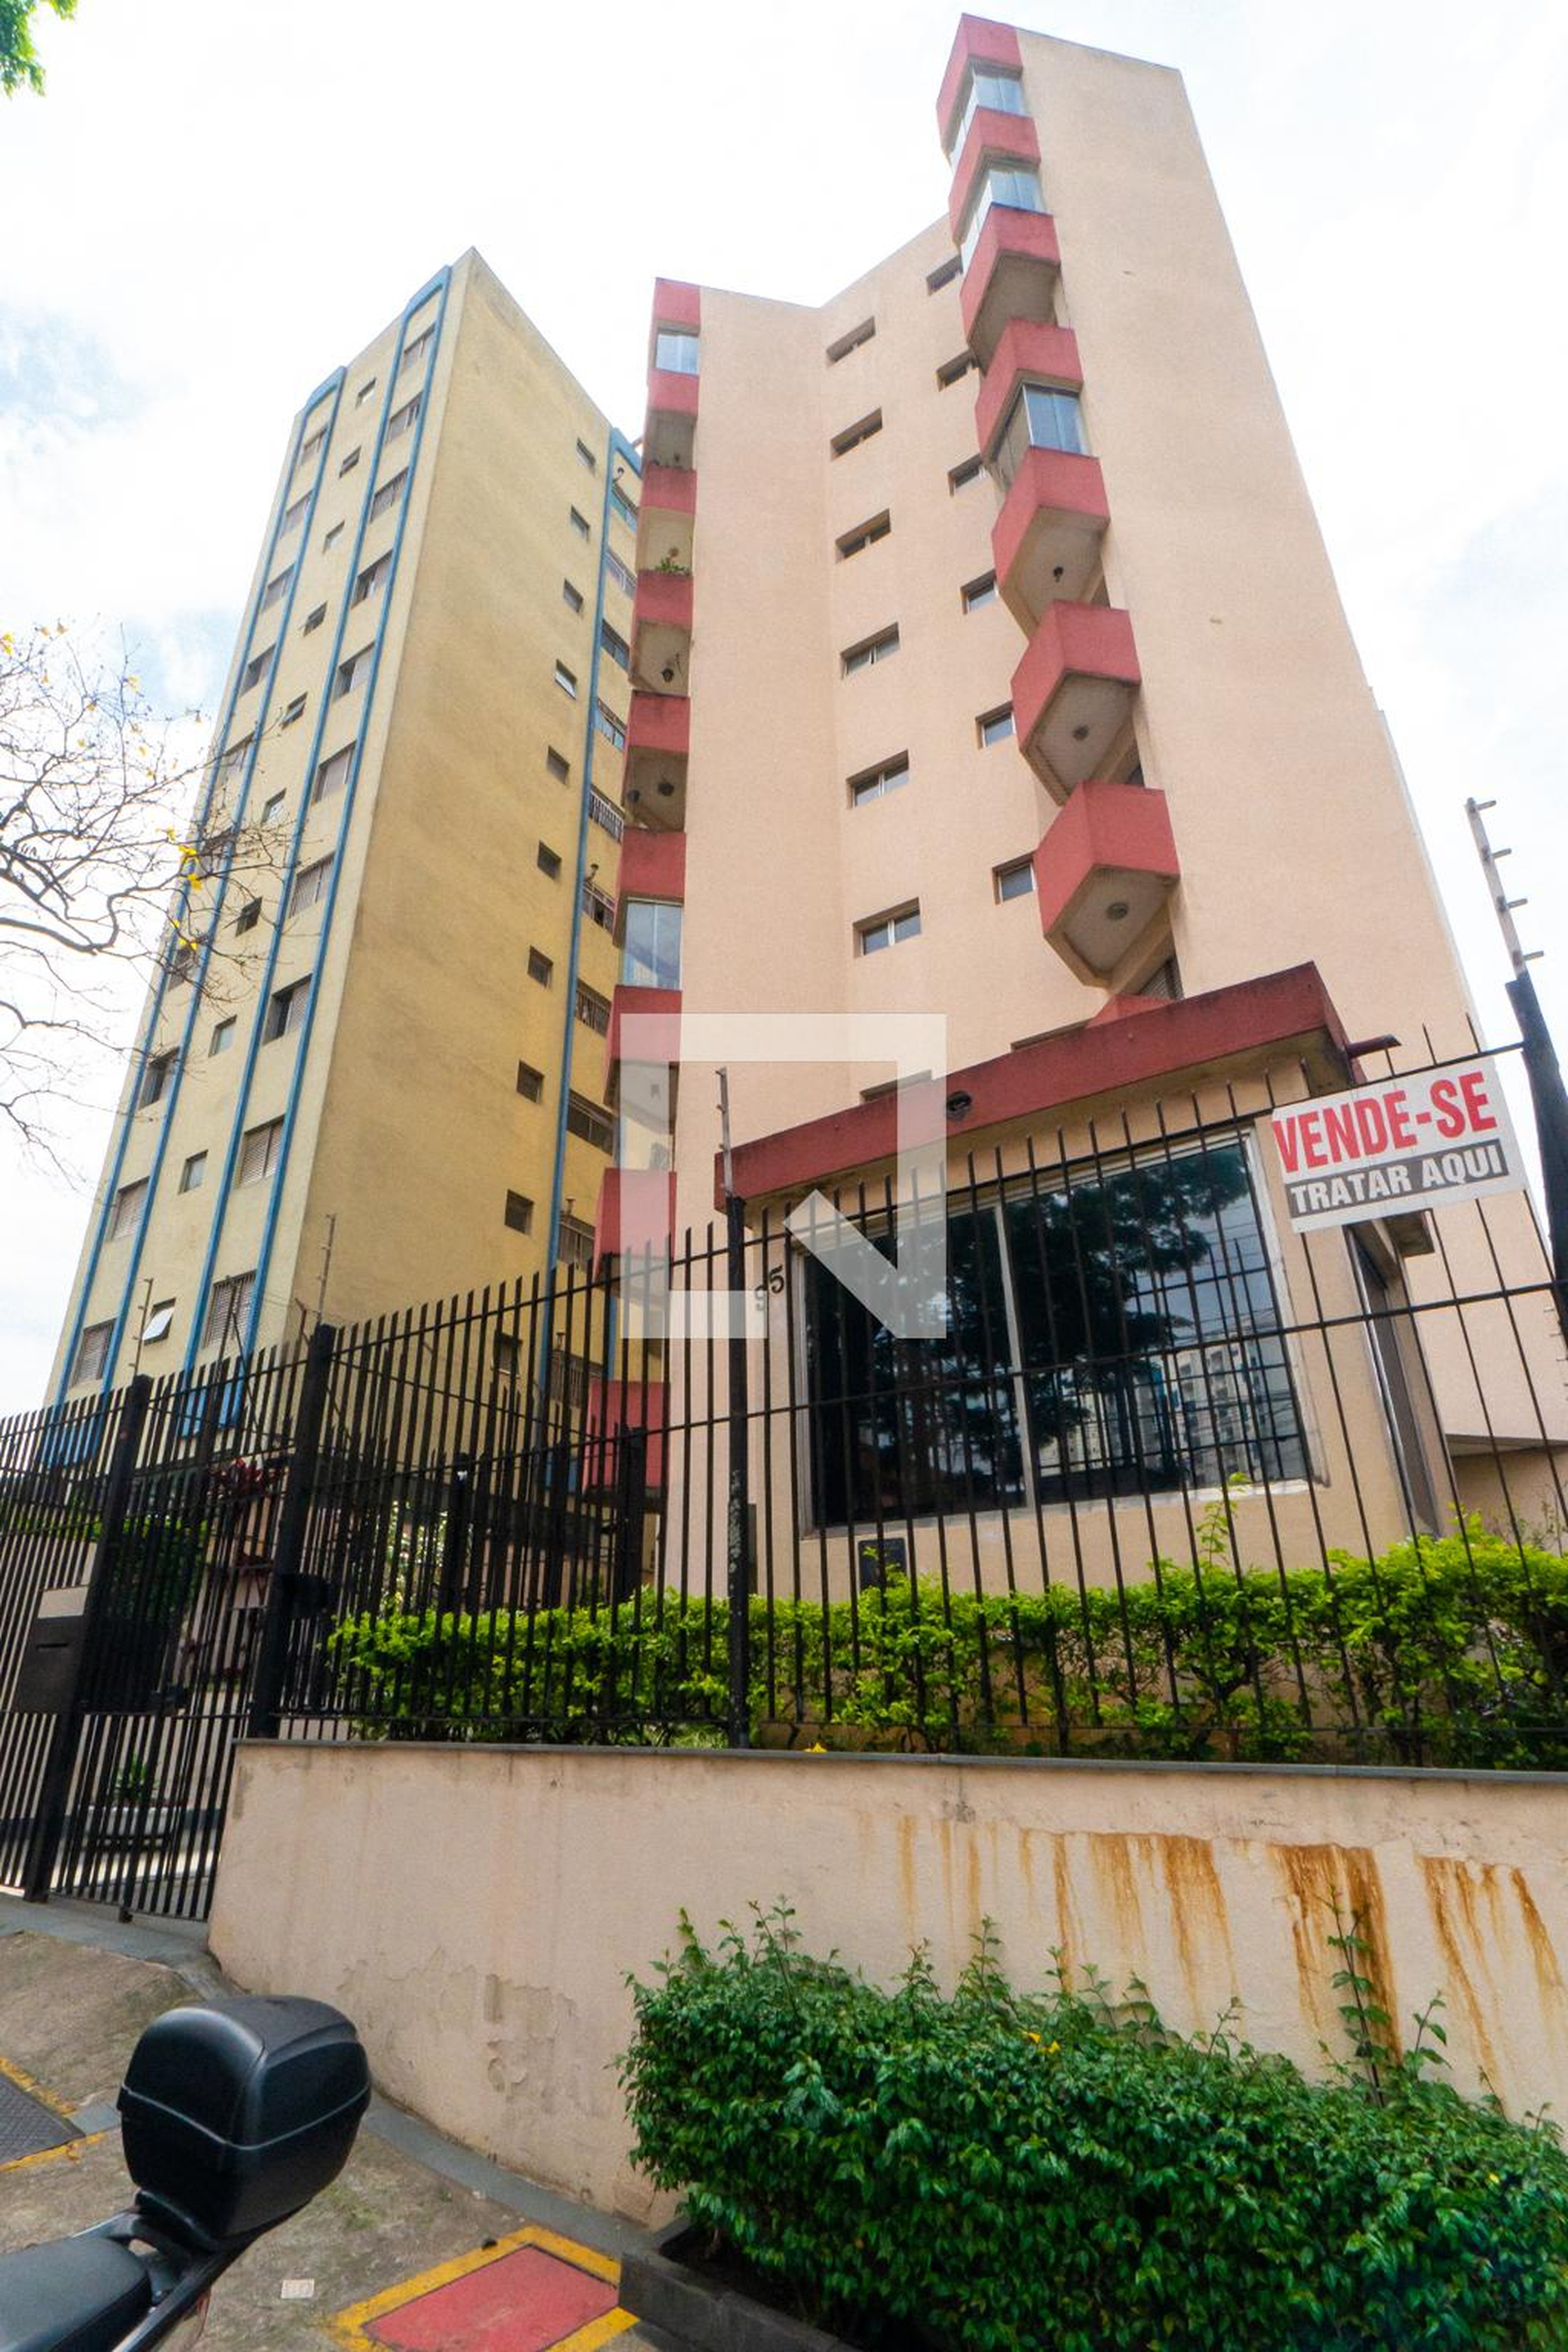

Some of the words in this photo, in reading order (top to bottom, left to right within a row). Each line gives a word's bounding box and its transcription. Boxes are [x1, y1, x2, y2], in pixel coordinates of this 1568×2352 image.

[1272, 1072, 1497, 1172] VENDE-SE
[1291, 1165, 1411, 1213] TRATAR
[1422, 1145, 1502, 1187] AQUI
